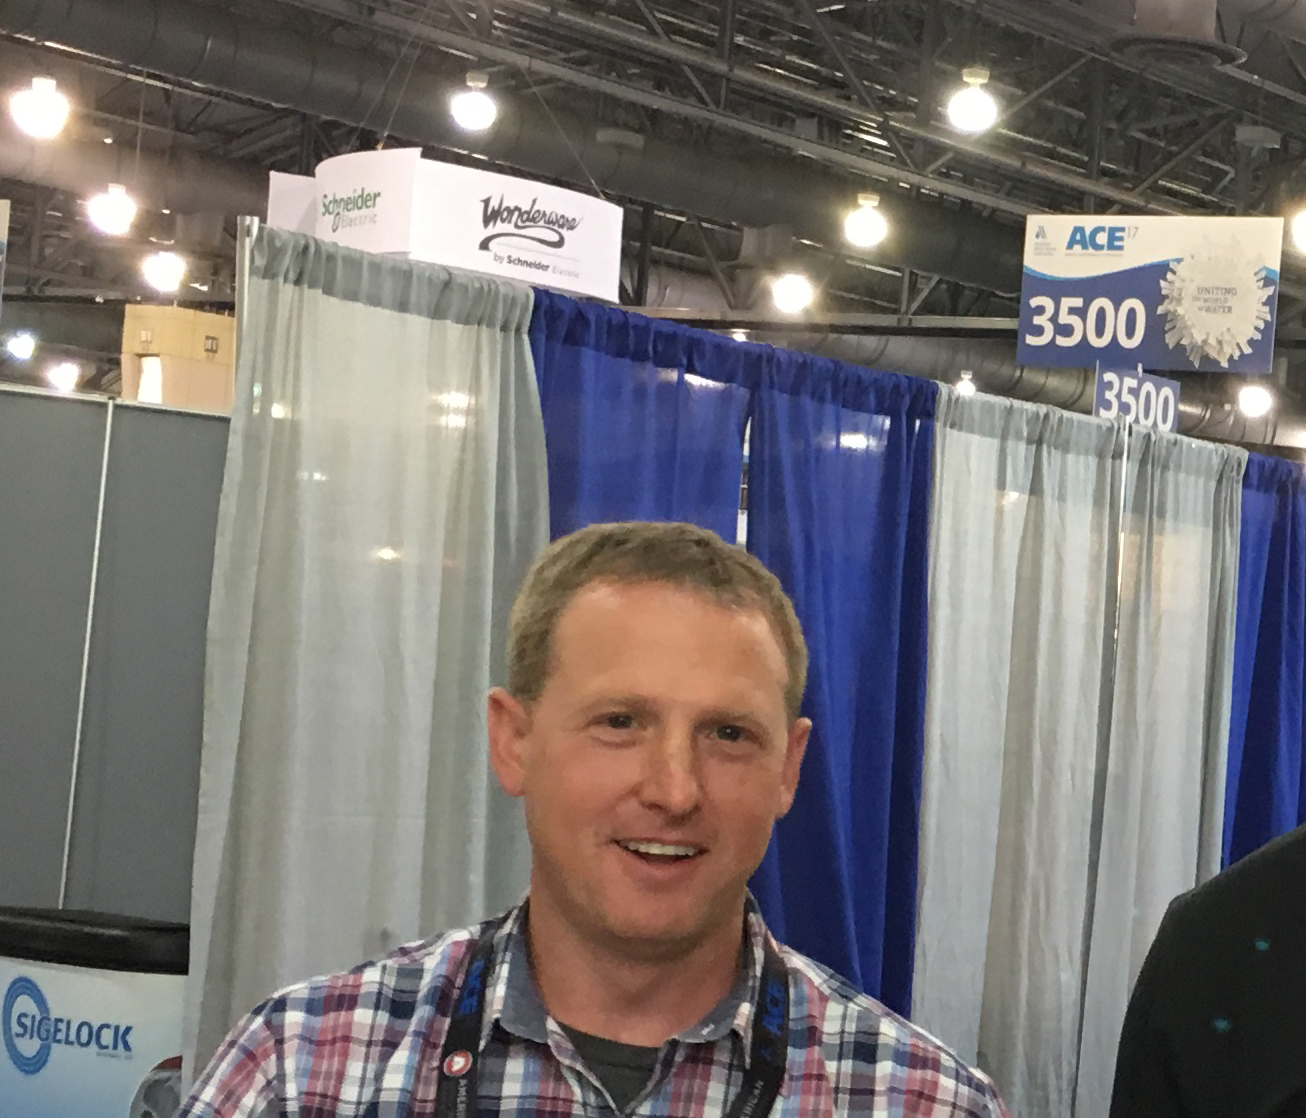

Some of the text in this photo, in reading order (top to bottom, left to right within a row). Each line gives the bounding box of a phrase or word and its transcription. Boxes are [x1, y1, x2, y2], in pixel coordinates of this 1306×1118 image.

[321, 187, 382, 217] Schneider
[479, 193, 583, 231] Wonderware
[1065, 225, 1126, 252] ACE
[506, 254, 551, 272] Schneider
[1025, 295, 1147, 350] 3500
[1099, 371, 1176, 431] 3500
[14, 1011, 134, 1053] SIGELOCK
